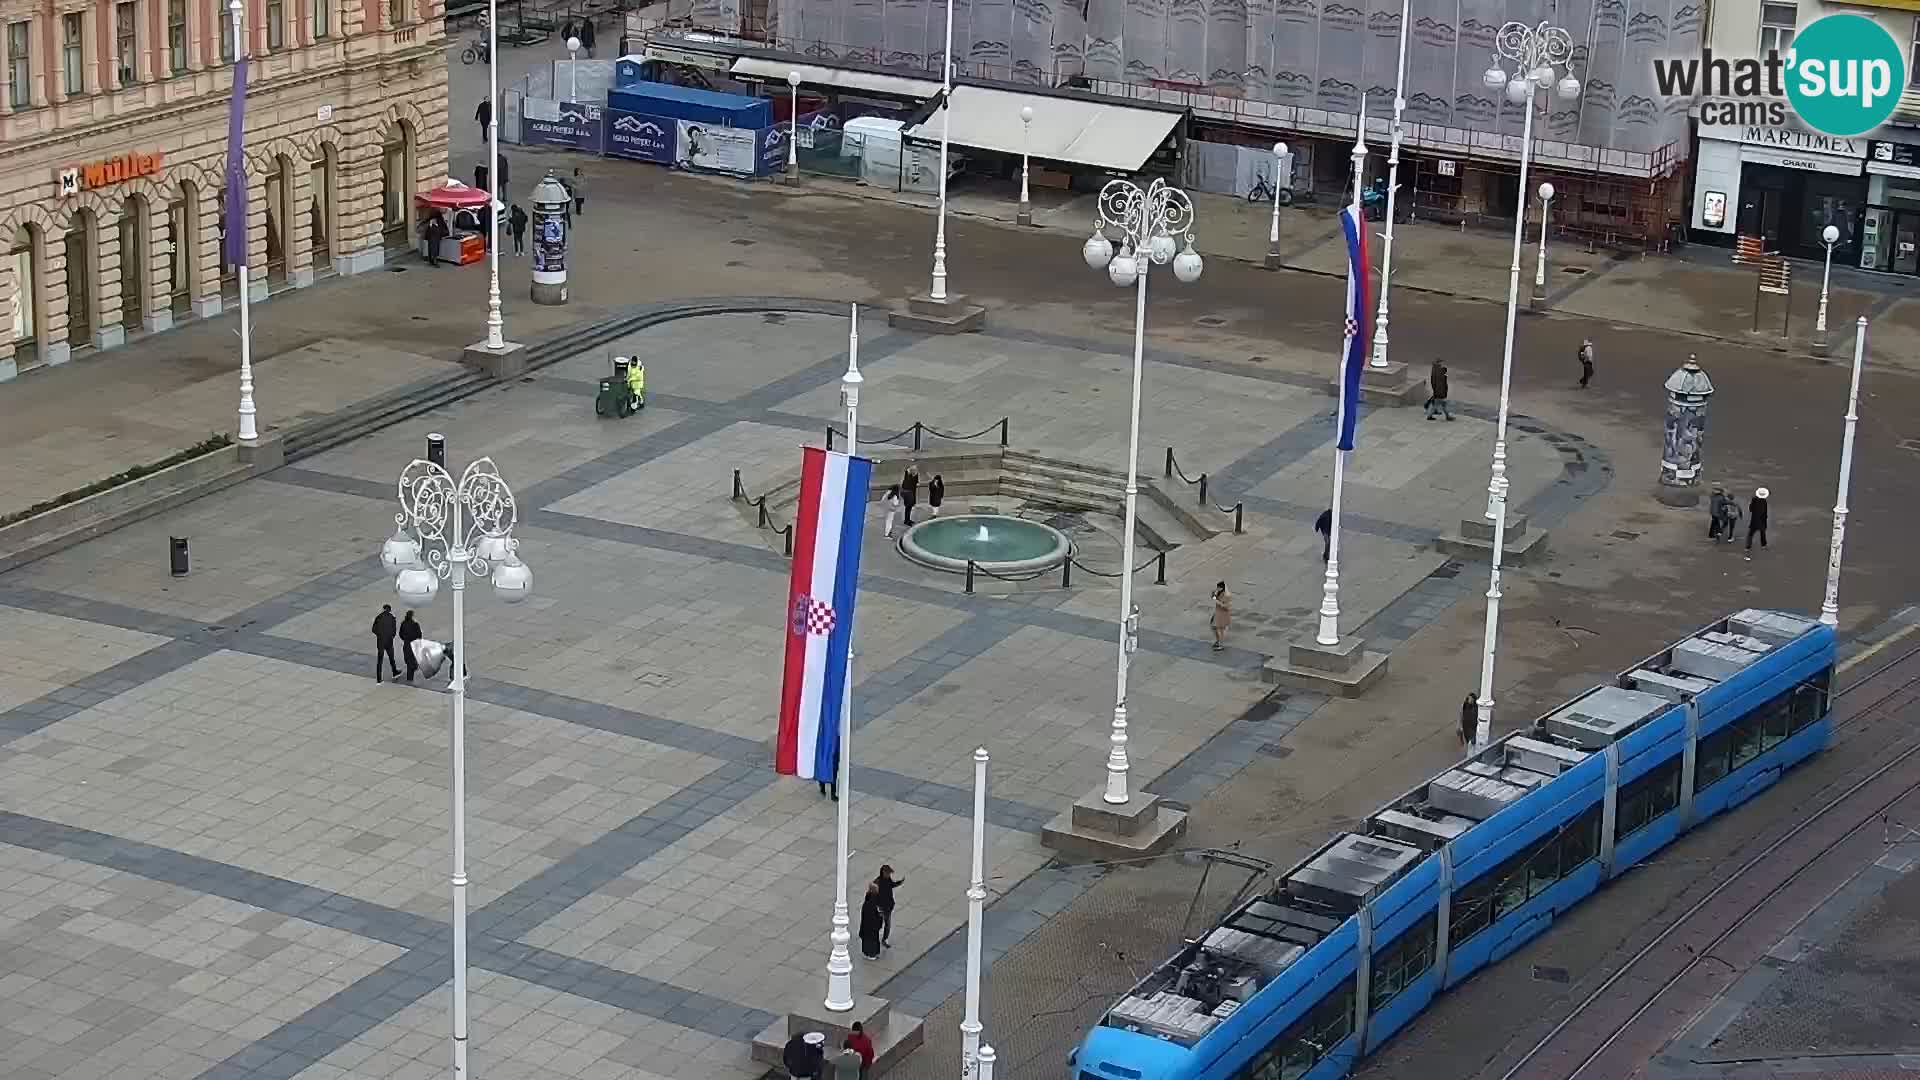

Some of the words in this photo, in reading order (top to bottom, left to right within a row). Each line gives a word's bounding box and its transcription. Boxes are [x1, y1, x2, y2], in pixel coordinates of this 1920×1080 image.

[1746, 127, 1857, 154] MARTIMEX
[83, 153, 162, 187] Müller
[1782, 158, 1818, 170] CHANEL
